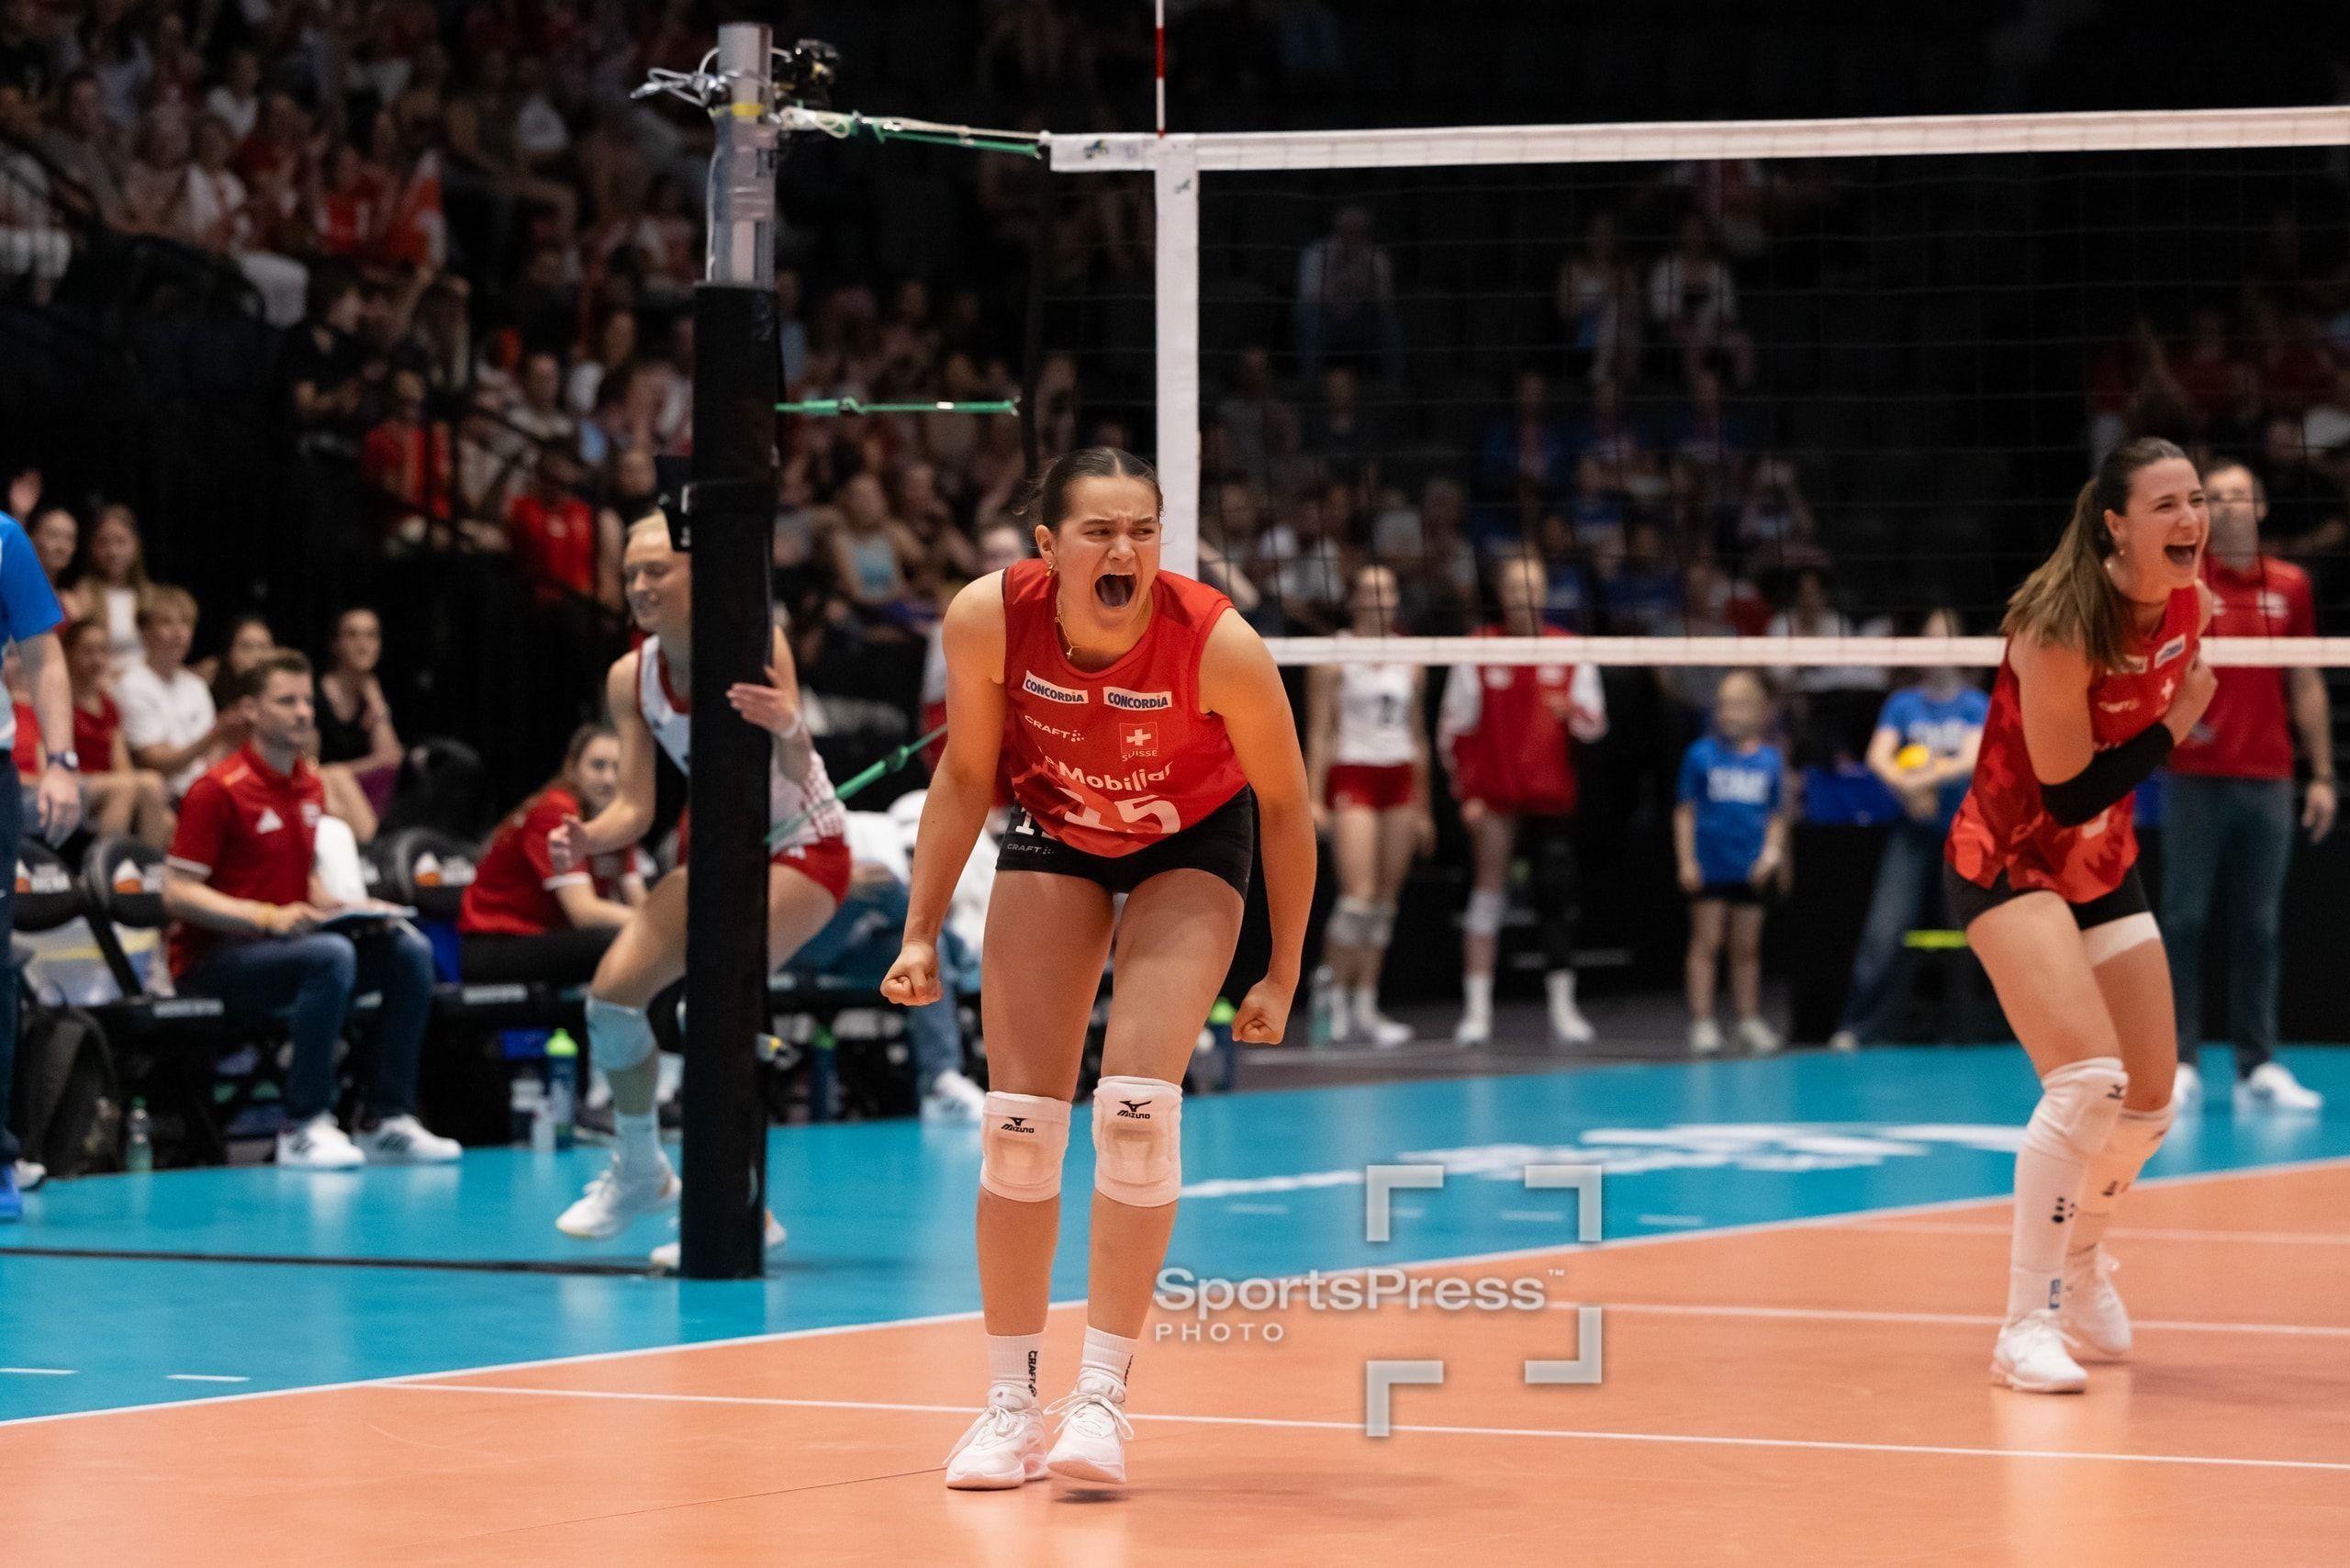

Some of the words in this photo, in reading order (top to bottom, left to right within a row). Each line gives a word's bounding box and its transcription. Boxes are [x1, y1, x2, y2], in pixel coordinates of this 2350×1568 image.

[1024, 715, 1070, 739] CRAFT
[1122, 749, 1158, 762] SUISSE
[1058, 761, 1174, 791] Mobiliar
[1007, 844, 1042, 853] CRAFT
[1117, 1109, 1150, 1119] MIZUNO
[1001, 1123, 1035, 1134] MIZUNO
[1028, 1350, 1038, 1383] CRAFT
